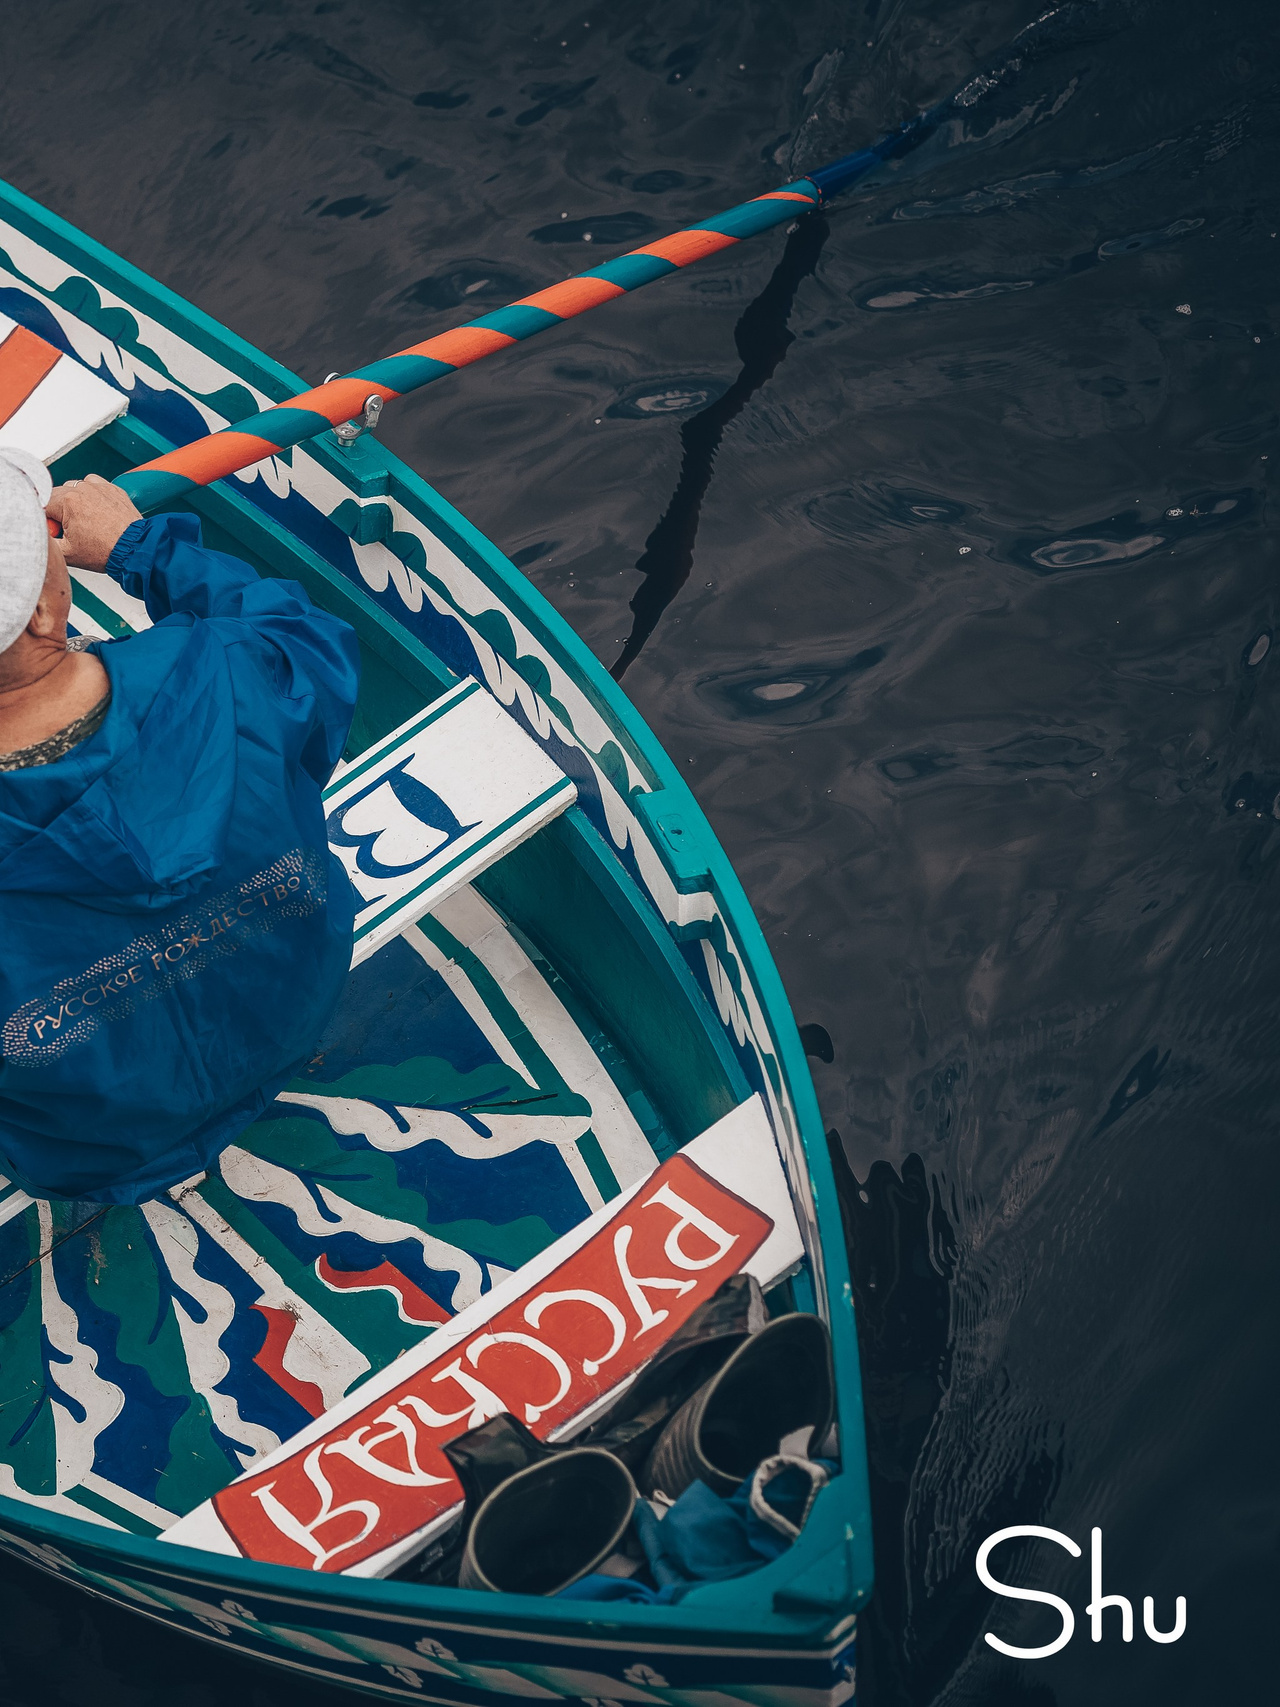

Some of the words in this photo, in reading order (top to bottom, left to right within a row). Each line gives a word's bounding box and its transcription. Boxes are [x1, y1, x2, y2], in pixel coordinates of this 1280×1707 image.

[33, 964, 144, 1039] РУССКОЕ
[151, 876, 301, 971] РОЖДЕСТВО
[251, 1182, 739, 1572] РУССКАЯ
